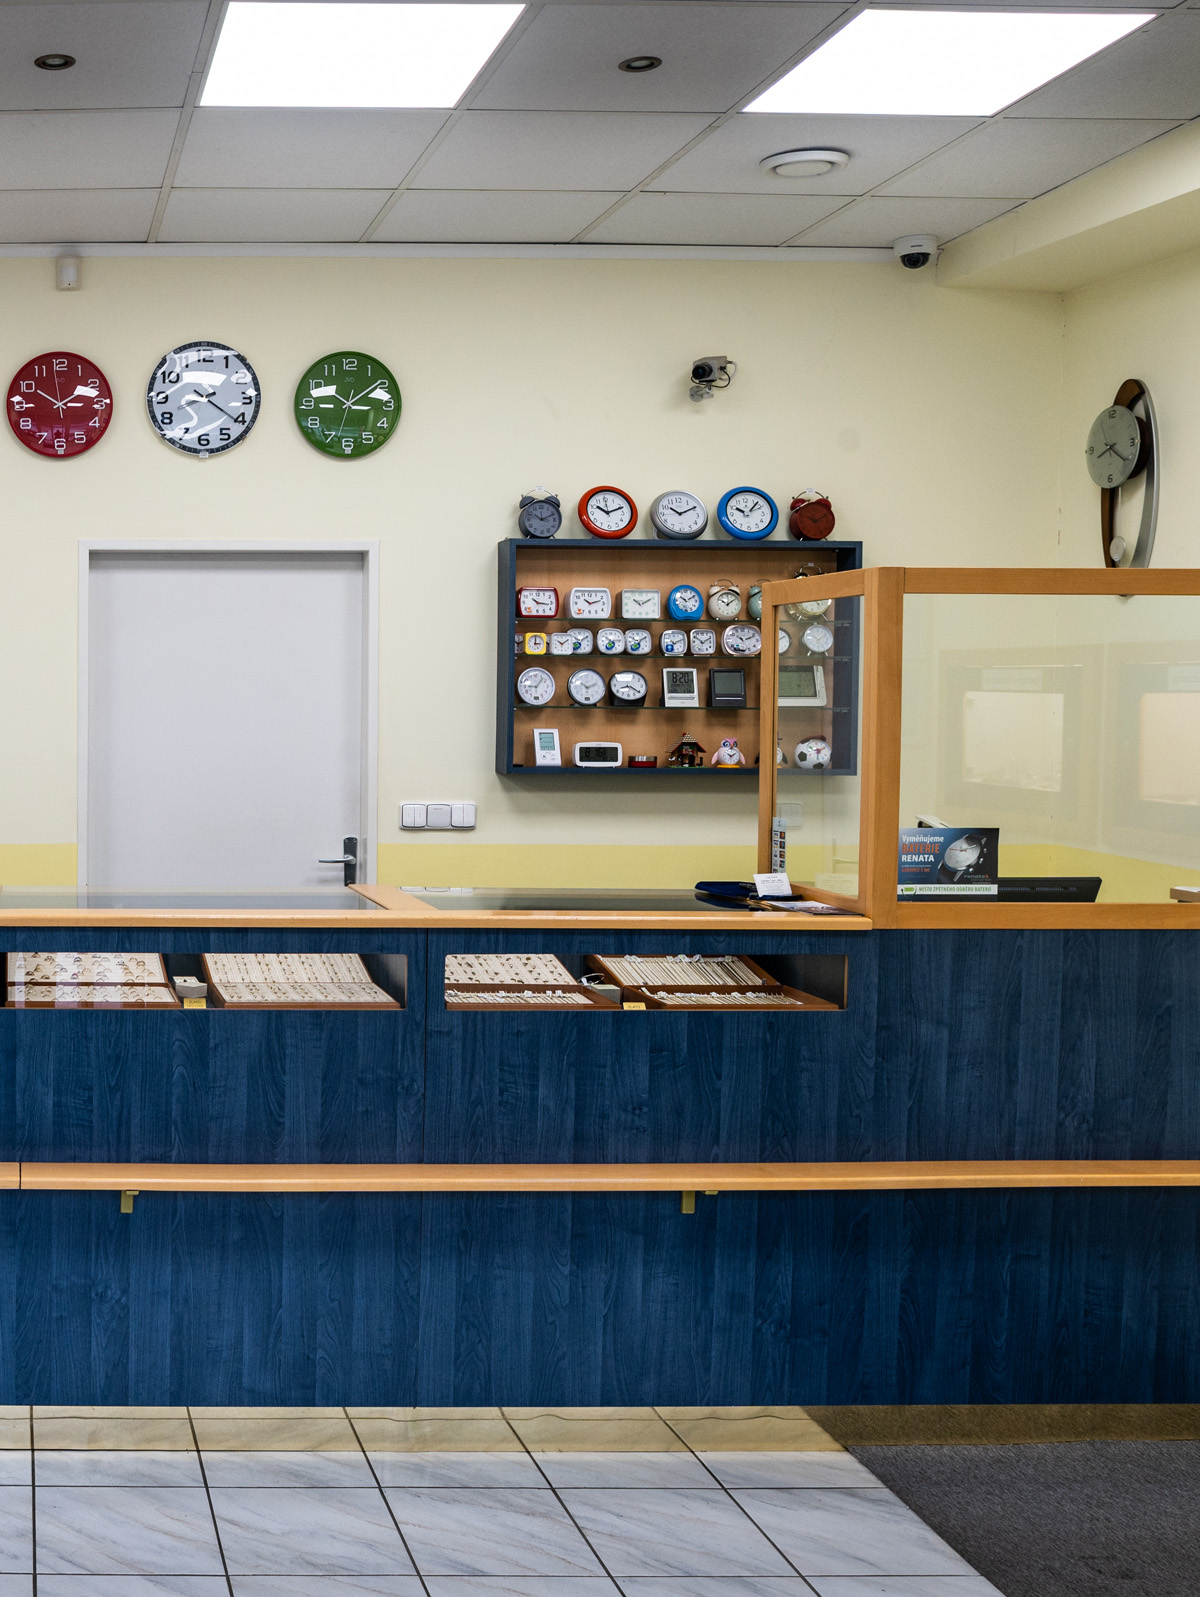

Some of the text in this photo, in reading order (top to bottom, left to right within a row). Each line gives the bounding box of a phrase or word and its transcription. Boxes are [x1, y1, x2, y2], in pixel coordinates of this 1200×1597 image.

[196, 349, 214, 362] 12
[53, 359, 67, 370] 12
[178, 355, 189, 368] 11
[224, 356, 229, 368] 1
[342, 359, 357, 370] 12
[35, 366, 46, 377] 11
[78, 365, 81, 376] 1
[324, 365, 335, 376] 11
[368, 365, 371, 376] 1
[161, 371, 180, 383] 10
[236, 371, 247, 384] 2
[20, 381, 35, 392] 10
[88, 379, 99, 390] 2
[309, 380, 324, 391] 10
[377, 380, 388, 391] 2
[156, 391, 168, 404] 9
[241, 392, 252, 405] 3
[94, 398, 105, 409] 3
[303, 398, 314, 409] 9
[383, 399, 394, 410] 3
[161, 412, 173, 425] 8
[234, 412, 246, 425] 4
[1109, 410, 1116, 418] 12
[20, 418, 31, 429] 8
[89, 417, 100, 428] 4
[308, 417, 319, 427] 8
[377, 417, 388, 428] 4
[36, 433, 48, 444] 7
[74, 432, 86, 443] 5
[198, 434, 210, 446] 6
[220, 428, 231, 441] 5
[324, 432, 335, 443] 7
[362, 432, 373, 443] 5
[55, 439, 66, 450] 6
[342, 438, 353, 449] 6
[1129, 438, 1135, 446] 3
[1108, 474, 1113, 483] 6
[672, 672, 689, 683] 8:20
[902, 835, 944, 843] Vyměňujeme
[902, 844, 940, 854] BATERIE
